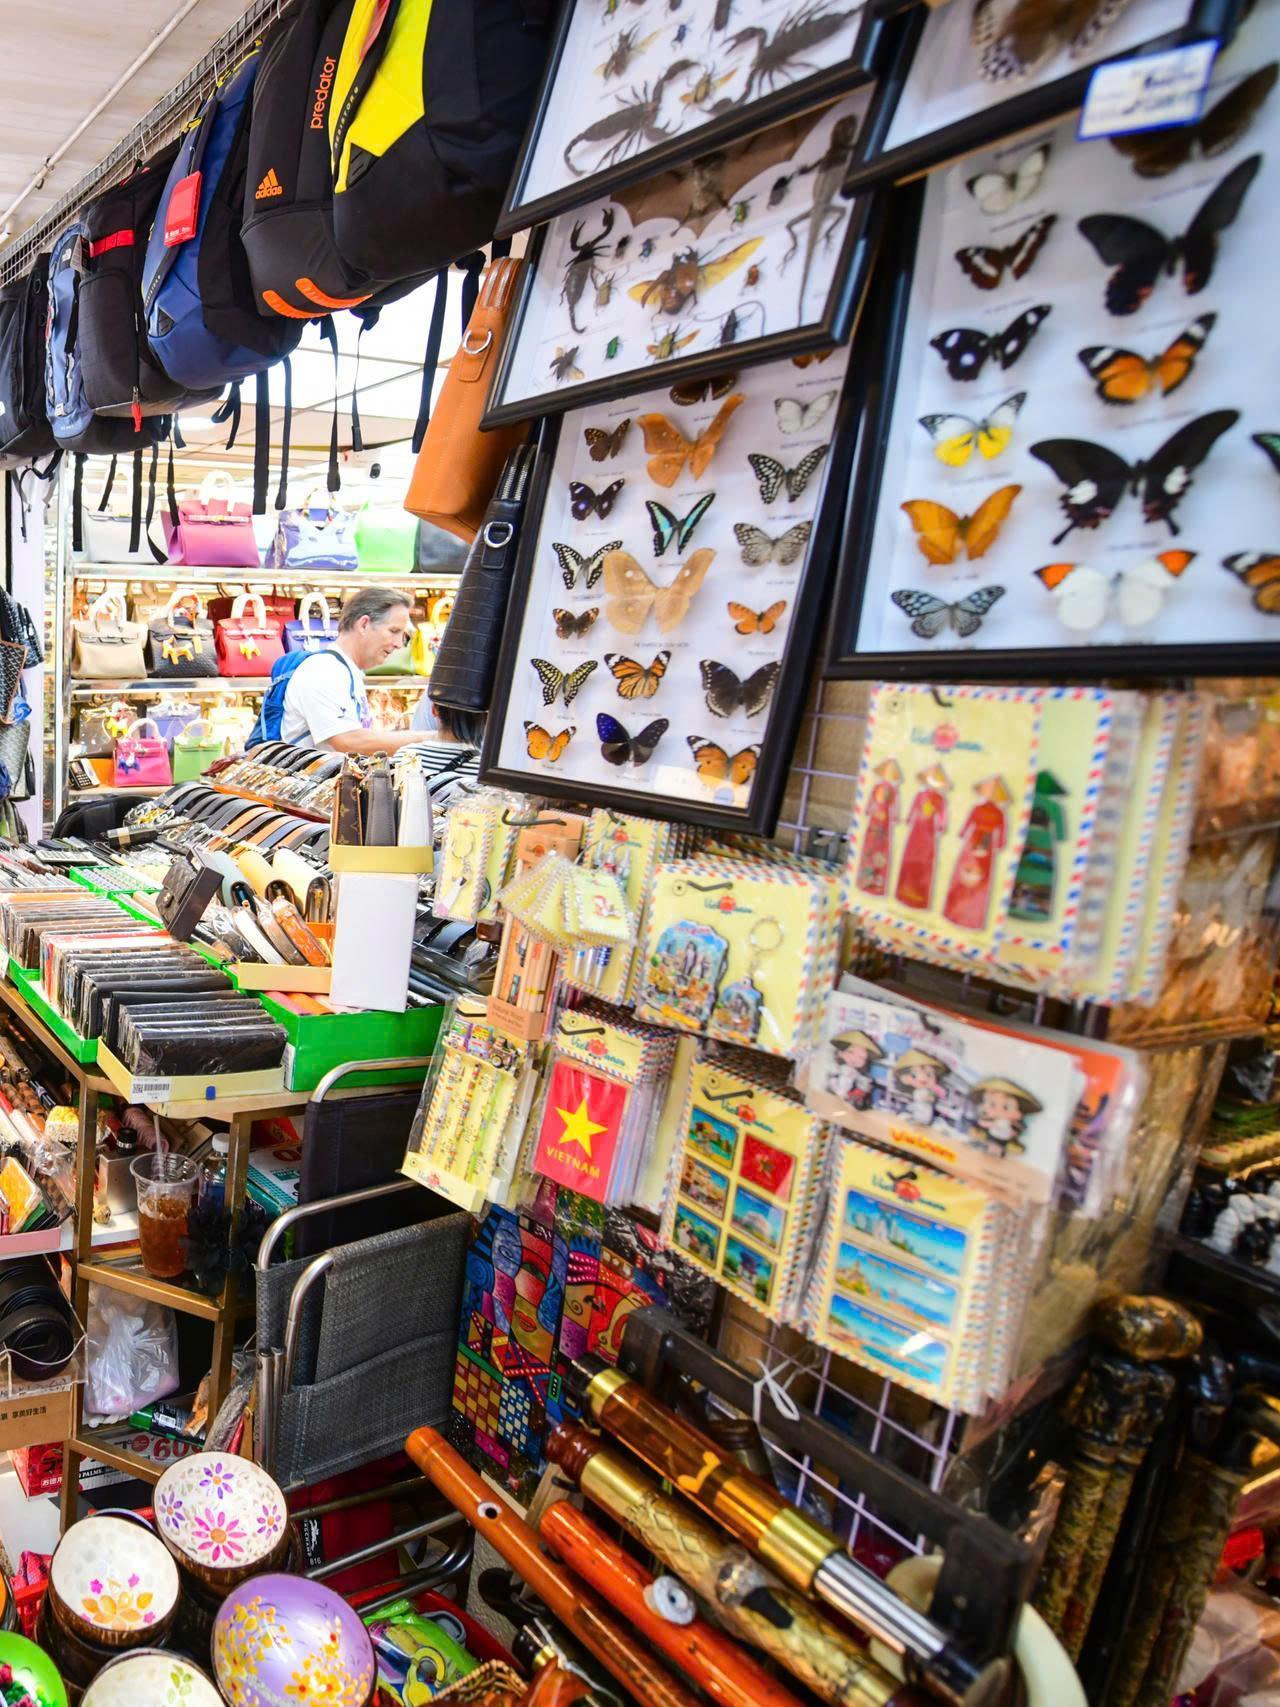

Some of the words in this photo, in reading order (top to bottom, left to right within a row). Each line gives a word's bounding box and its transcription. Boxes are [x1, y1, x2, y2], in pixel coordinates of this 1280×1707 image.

[310, 56, 337, 129] predator
[255, 185, 283, 200] adidas
[546, 1146, 601, 1179] VIETNAM
